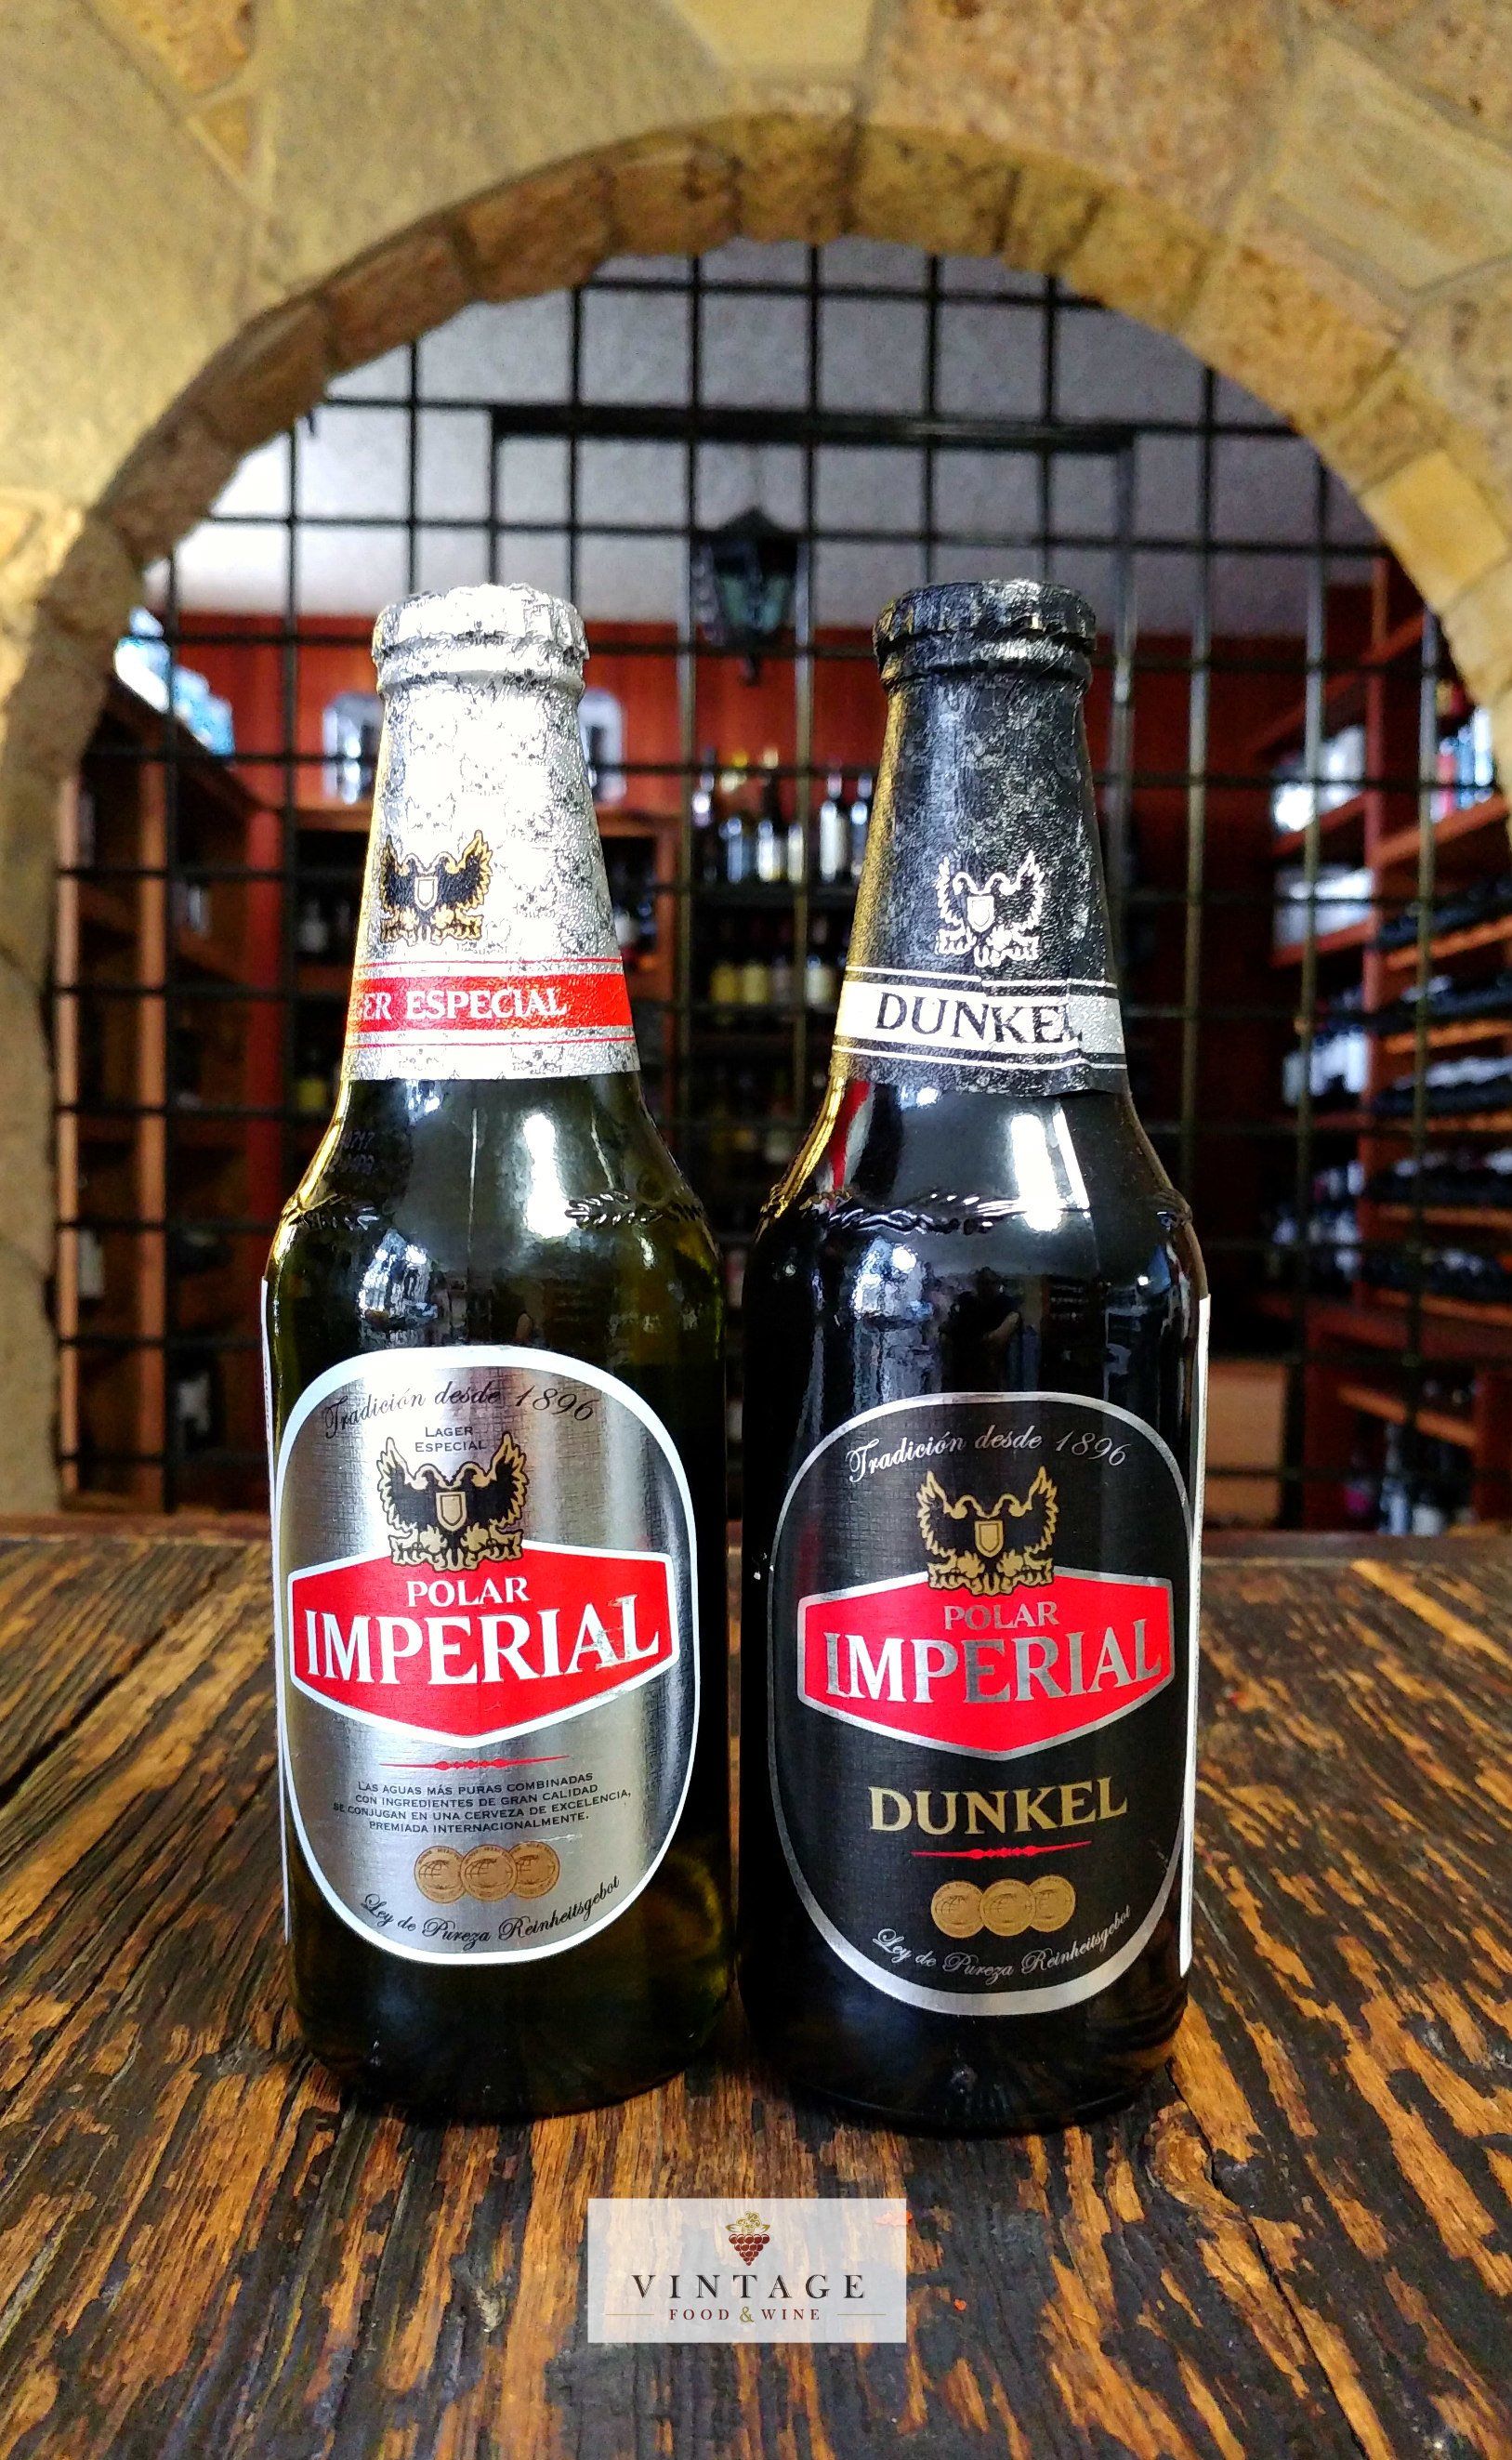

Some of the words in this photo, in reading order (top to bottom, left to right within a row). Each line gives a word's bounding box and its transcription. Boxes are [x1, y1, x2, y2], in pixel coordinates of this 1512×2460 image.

[358, 991, 392, 1020] ER
[405, 987, 567, 1020] ESPECIAL
[324, 1388, 426, 1439] Tradición
[435, 1381, 501, 1404] desde
[514, 1385, 600, 1421] 1896
[414, 1440, 487, 1454] ESPECIAL
[425, 1426, 473, 1438] LAGER
[845, 1430, 966, 1483] Tradición
[974, 1425, 1044, 1451] desde
[1054, 1429, 1129, 1467] 1896
[406, 1576, 531, 1608] POLAR
[943, 1600, 1059, 1631] POLAR
[305, 1594, 660, 1685] IMPERIAL
[822, 1618, 1162, 1704] IMPERIAL
[355, 1794, 377, 1805] CON
[381, 1796, 474, 1809] INGREDIENTES
[479, 1796, 496, 1807] DE
[500, 1794, 538, 1806] GRAN
[542, 1783, 598, 1801] CALIDAD
[358, 1781, 379, 1793] LAS
[382, 1783, 422, 1796] AGUAS
[427, 1783, 454, 1796] MÁS
[458, 1783, 503, 1796] PURAS
[506, 1772, 594, 1793] COMBINADAS
[333, 1802, 345, 1813] SE
[347, 1806, 407, 1821] CONJUGAN
[411, 1810, 427, 1821] EN
[432, 1809, 460, 1821] UNA
[465, 1808, 524, 1821] CERVEZA
[529, 1805, 547, 1816] DE
[551, 1788, 632, 1812] EXCELENCIA,
[867, 1776, 1128, 1836] DUNKEL
[369, 1821, 428, 1834] PREMIADA
[433, 1811, 590, 1834] INTERNACIONALMENTE.
[362, 1892, 394, 1929] Ley
[397, 1915, 417, 1932] de
[421, 1916, 492, 1952] Pureza
[497, 1875, 621, 1942] Reinheitsgebot
[870, 1927, 912, 1964] Ley
[914, 1950, 937, 1967] de
[942, 1952, 1015, 1986] Pureza
[1020, 1904, 1132, 1975] Reinheitsgebot
